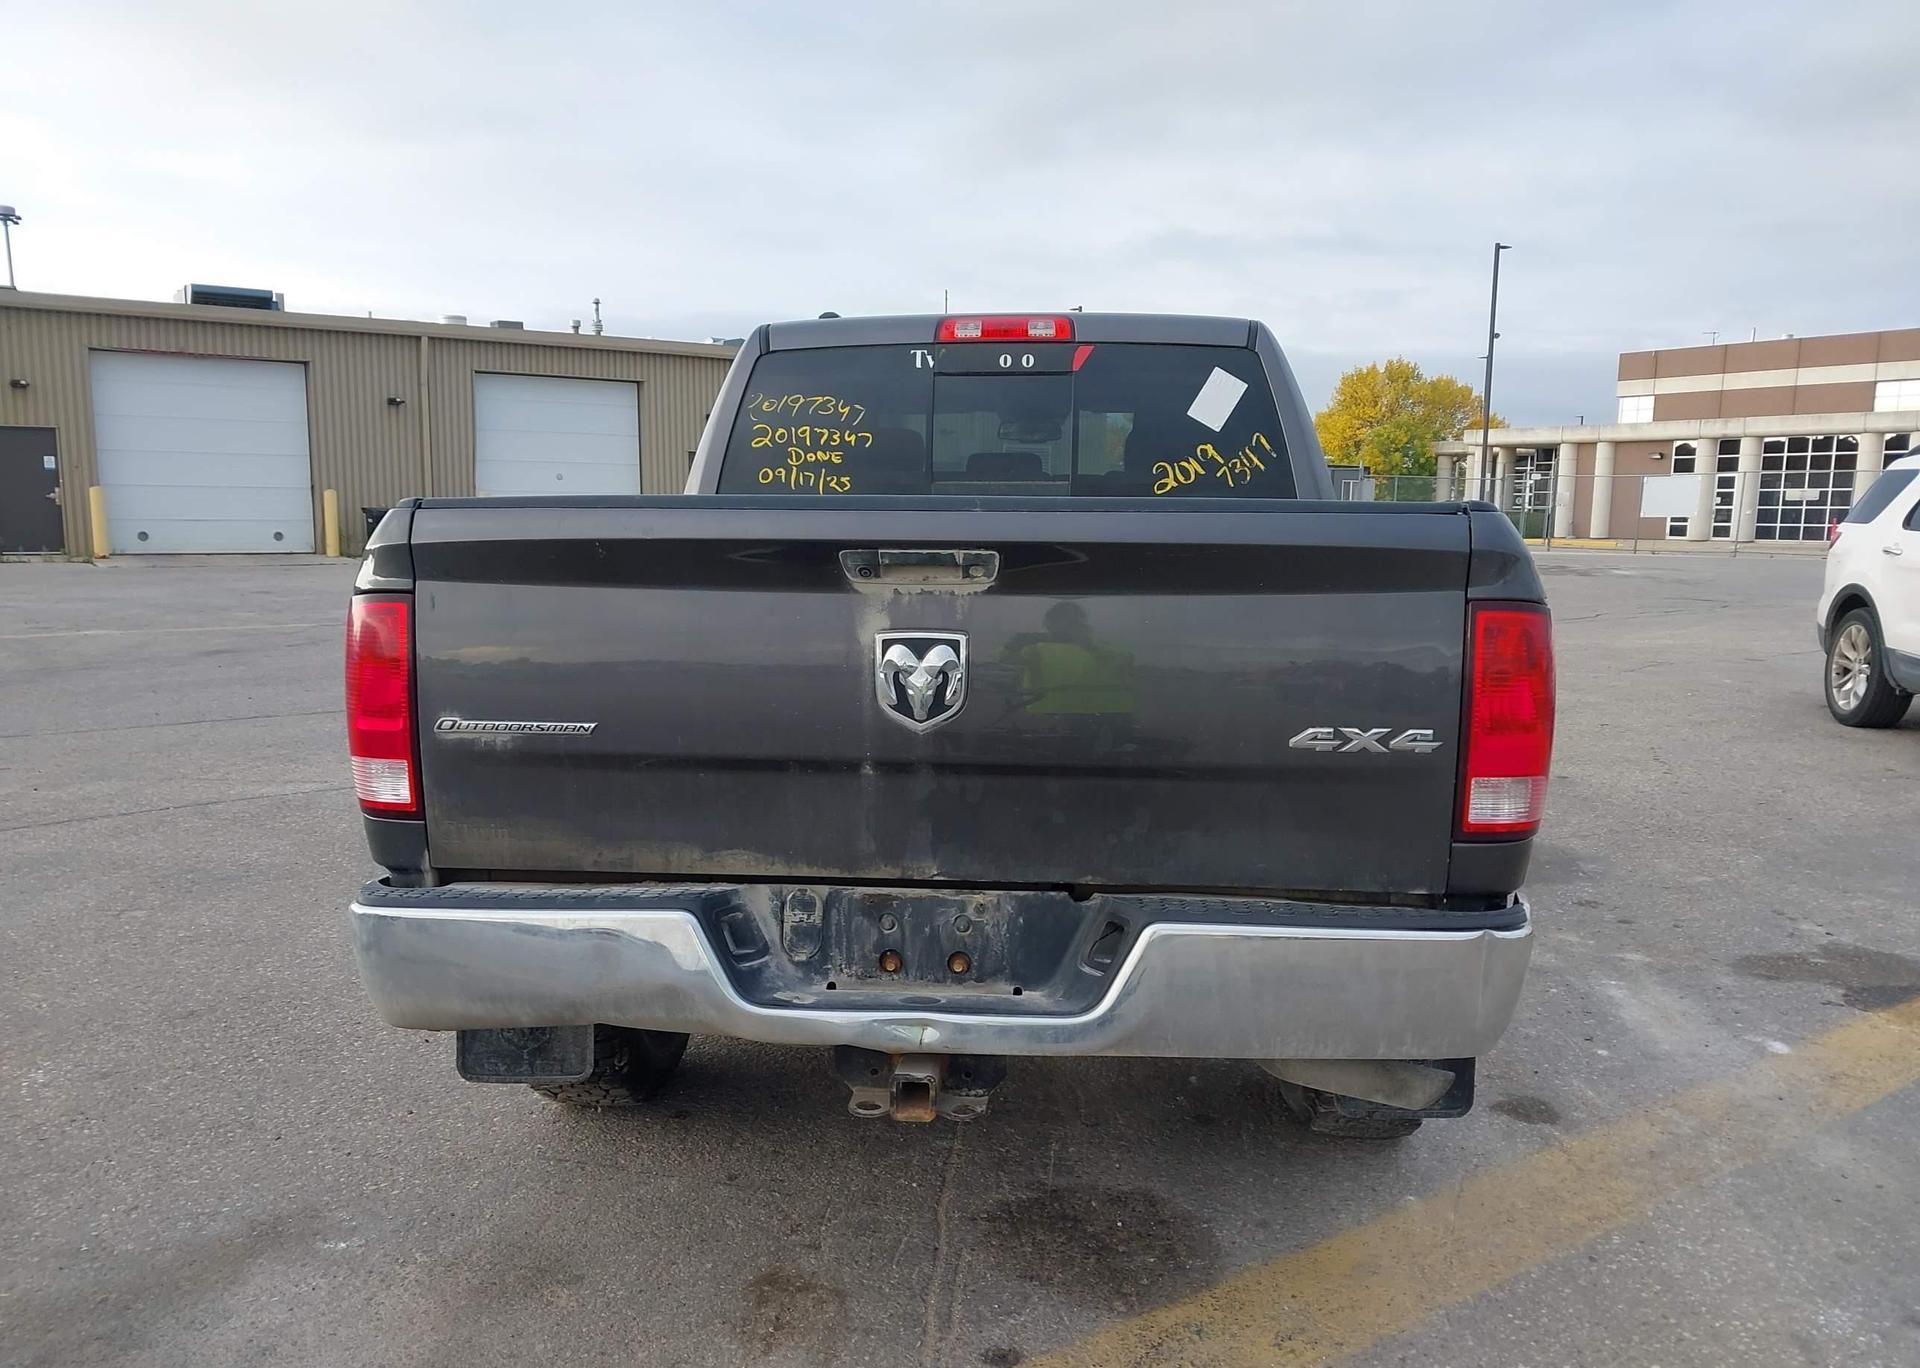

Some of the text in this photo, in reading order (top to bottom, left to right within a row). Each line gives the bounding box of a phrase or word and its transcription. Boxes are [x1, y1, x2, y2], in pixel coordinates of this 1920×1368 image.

[748, 393, 865, 425] 20197347
[751, 424, 873, 448] 20197347
[787, 447, 844, 465] DONE
[1152, 443, 1225, 495] 2019
[758, 465, 851, 495] 09/17/25
[434, 717, 599, 735] OUTDOORSMAN
[1288, 727, 1444, 753] 4X4
